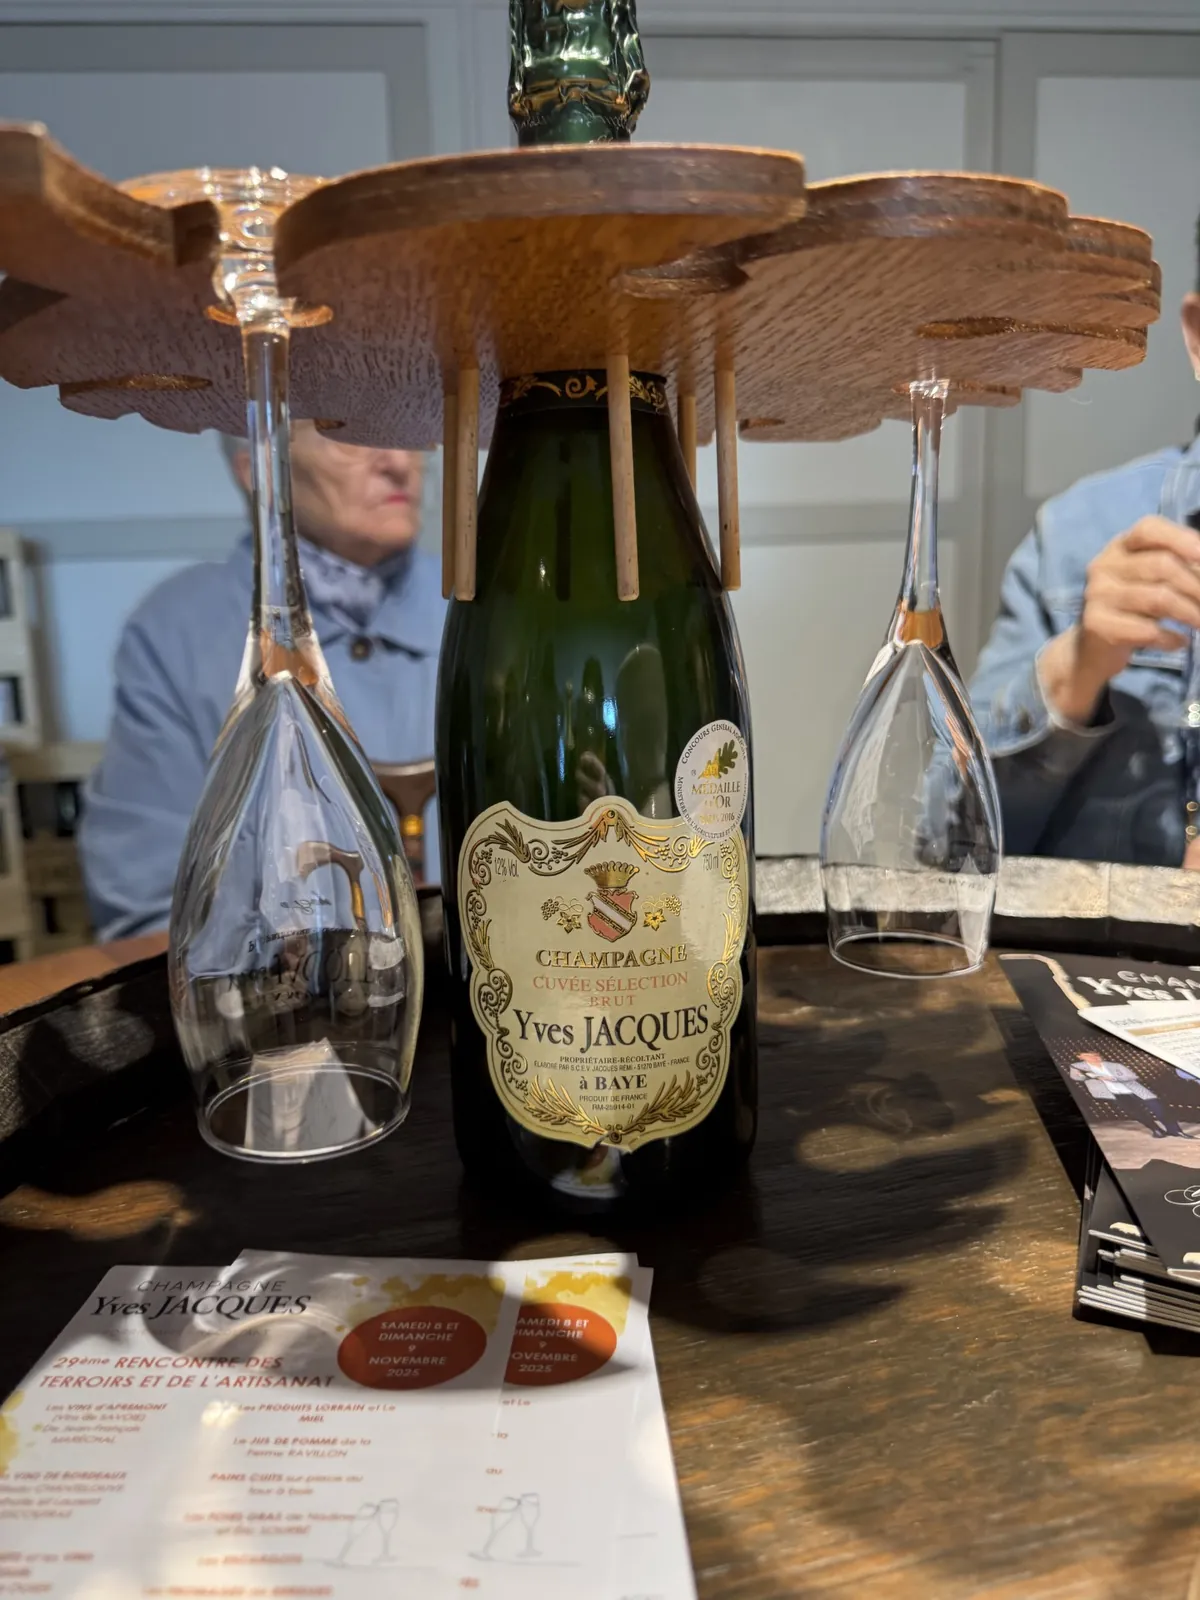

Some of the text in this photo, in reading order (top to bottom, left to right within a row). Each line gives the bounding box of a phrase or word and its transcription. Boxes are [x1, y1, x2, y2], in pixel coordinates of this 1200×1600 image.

[681, 728, 711, 765] CONCOURS
[691, 780, 741, 795] MÉDAILLE
[536, 944, 688, 969] CHAMPAGNE
[532, 971, 689, 992] CUVÉE SÉLECTION
[1077, 976, 1175, 1000] Yves
[589, 995, 637, 1008] BRUT
[512, 1004, 709, 1054] Yves JACQUES
[558, 1063, 570, 1071] PAR
[652, 1059, 667, 1069] BAYE
[670, 1056, 690, 1066] FRANCE
[559, 1053, 666, 1065] PROPRIÉTAIRE-RÉCOLTANT
[579, 1074, 648, 1091] à BAYE
[579, 1093, 648, 1102] PRODUIT DE FRANCE
[137, 1280, 287, 1292] CHAMPAGNE
[91, 1295, 312, 1320] Yves JACQUES
[380, 1321, 431, 1330] SAMEDI
[446, 1322, 460, 1330] ET
[517, 1317, 560, 1327] AMEDI
[575, 1318, 590, 1328] ET
[378, 1333, 455, 1342] DIMANCHE
[408, 1344, 416, 1352] 9
[53, 1356, 284, 1369] 29ème RENCONTRE DES
[368, 1356, 448, 1365] NOVEMBRE
[512, 1352, 579, 1362] OVEMBRE
[386, 1368, 420, 1377] 2025
[518, 1364, 554, 1373] 2025
[39, 1374, 336, 1388] TERROIRS ET DE L'ARTISANAT
[259, 1403, 312, 1412] PRODUITS
[315, 1403, 366, 1412] LORRAIN
[298, 1415, 325, 1423] MIEL
[273, 1437, 289, 1446] DE
[291, 1437, 338, 1446] POMME
